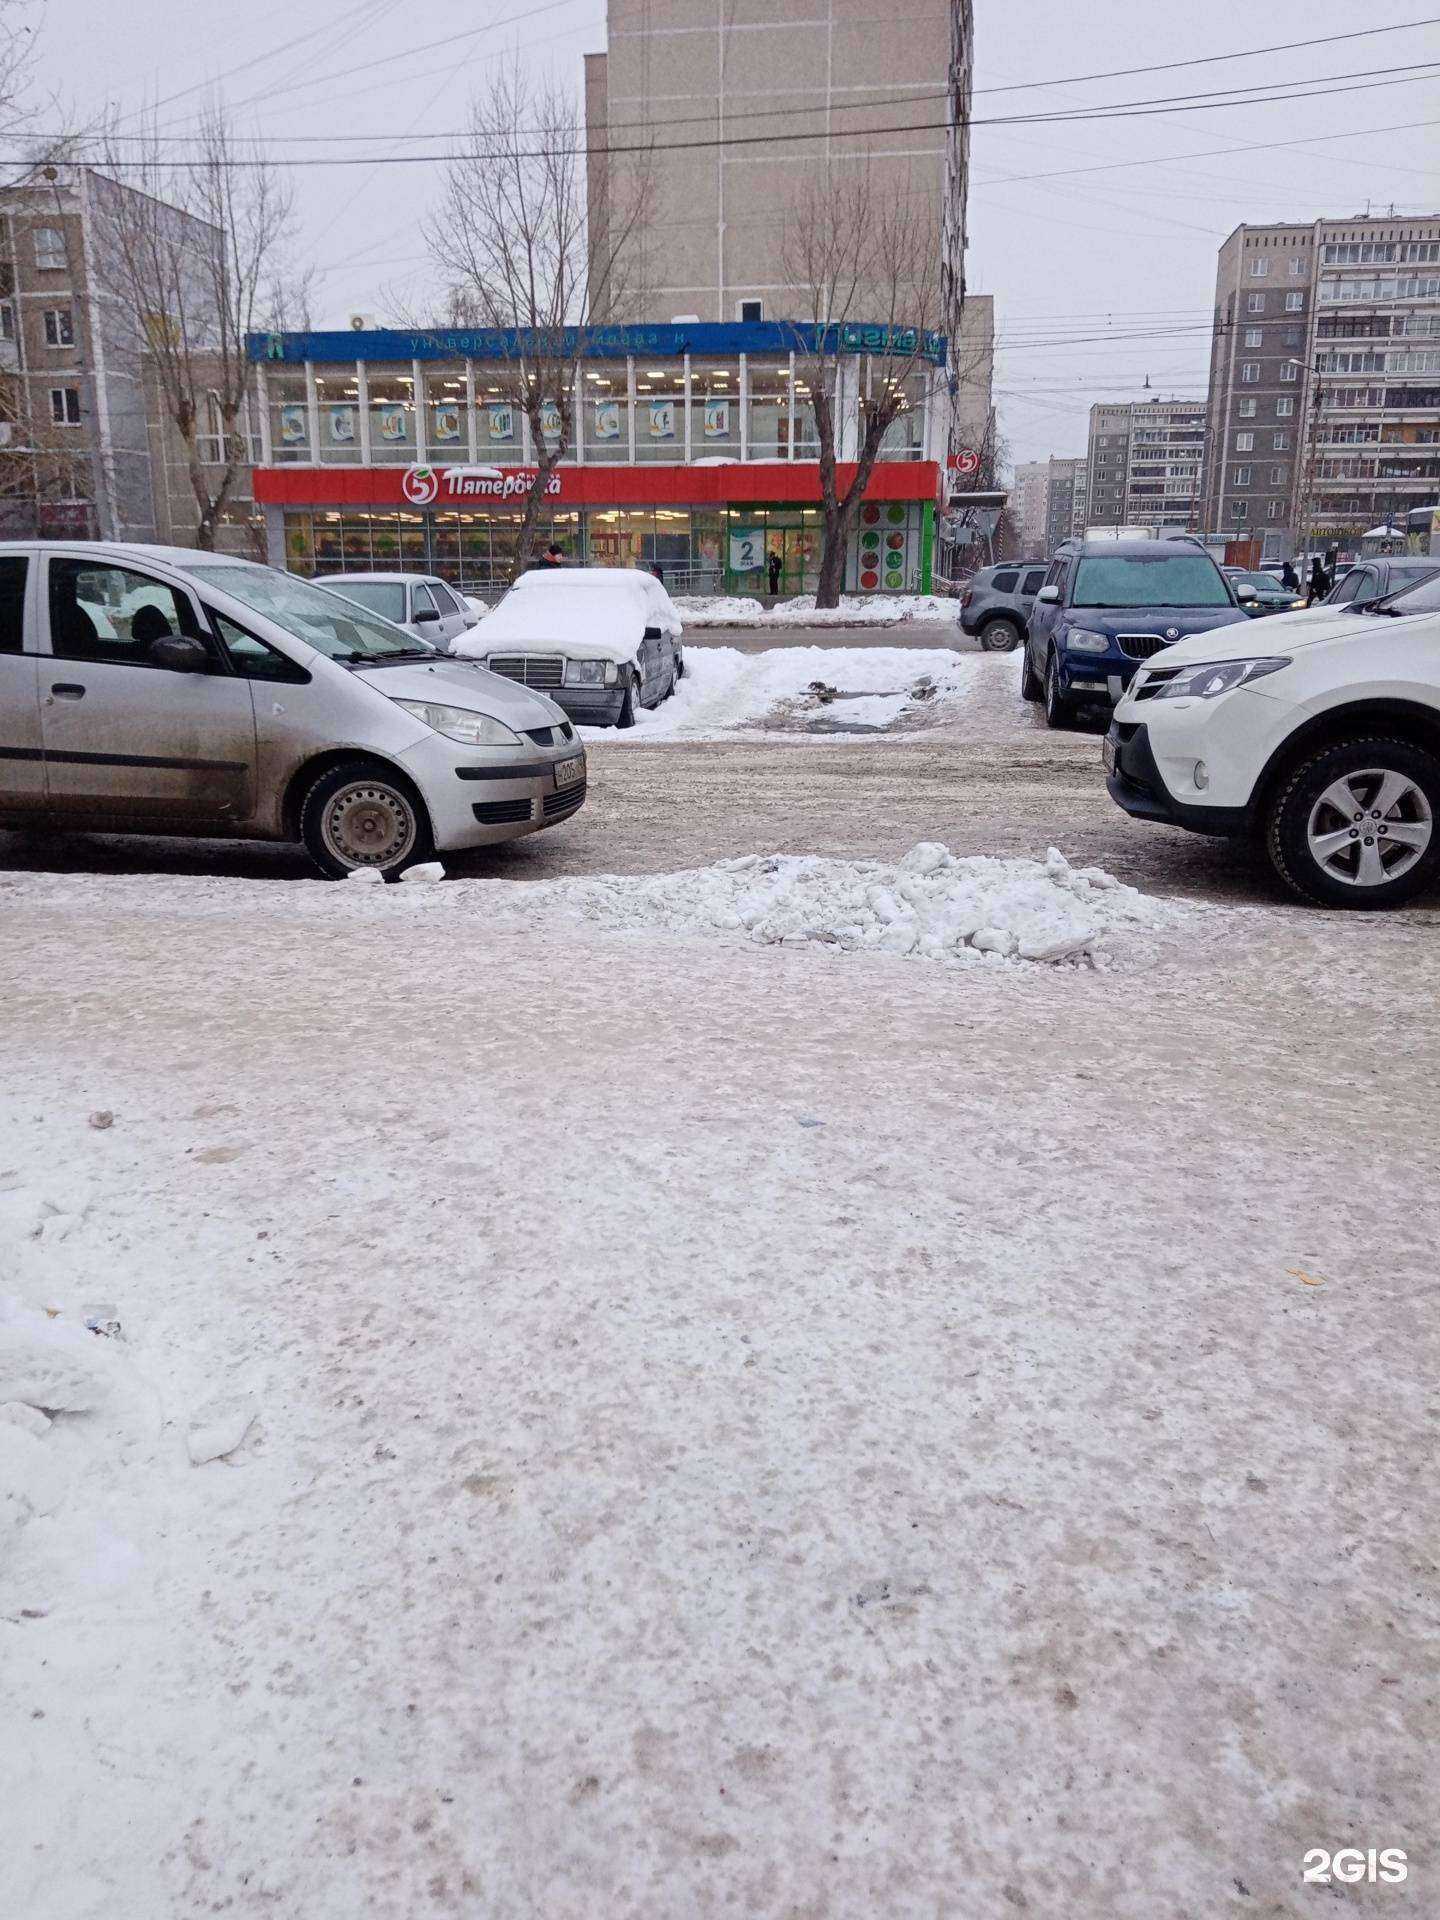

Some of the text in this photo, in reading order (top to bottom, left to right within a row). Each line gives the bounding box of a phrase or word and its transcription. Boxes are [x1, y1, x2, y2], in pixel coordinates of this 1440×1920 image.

[409, 467, 562, 503] 5 Пятероча
[740, 541, 754, 560] 2
